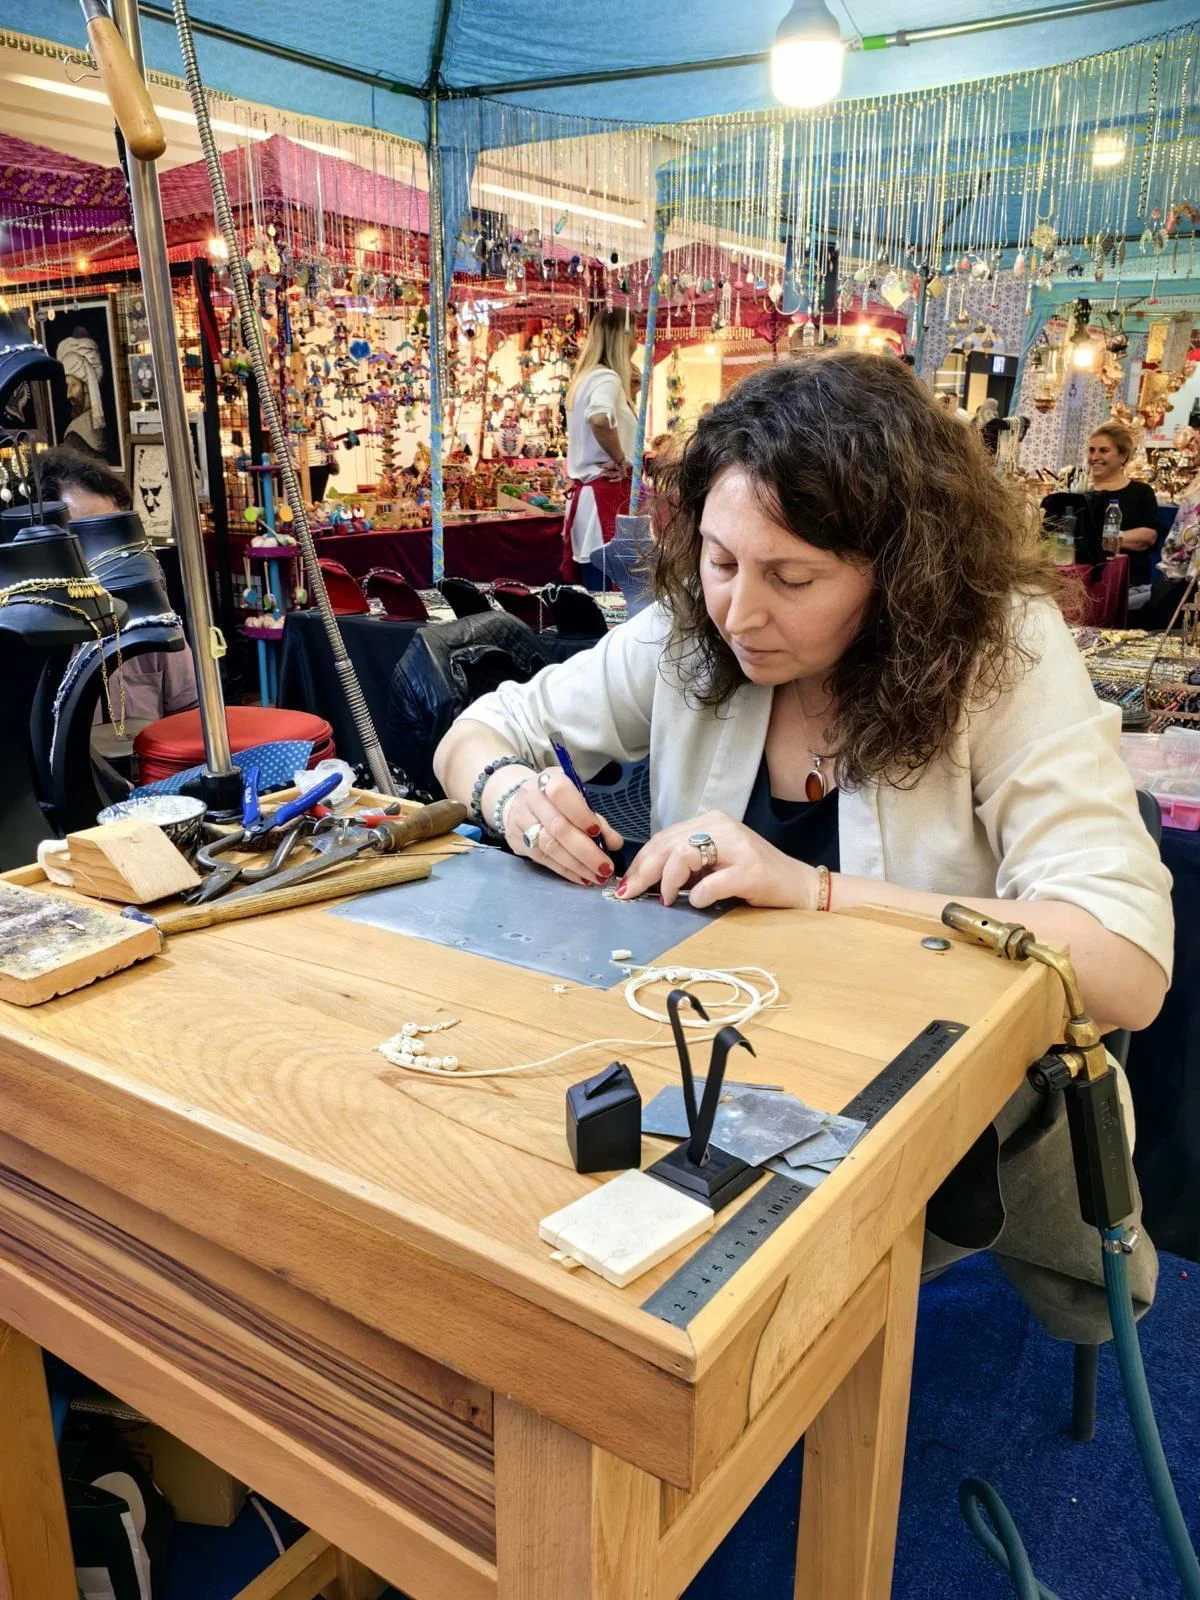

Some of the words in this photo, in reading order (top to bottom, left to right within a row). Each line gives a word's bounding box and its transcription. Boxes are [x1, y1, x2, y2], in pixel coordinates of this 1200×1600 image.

[674, 1303, 686, 1311] 2
[687, 1289, 698, 1298] 3
[701, 1276, 711, 1284] 4
[712, 1264, 723, 1272] 5
[725, 1252, 736, 1260] 6
[747, 1229, 758, 1237] 8
[758, 1217, 768, 1225] 9
[767, 1204, 784, 1216] 10
[779, 1195, 792, 1205] 11
[789, 1184, 802, 1194] 12
